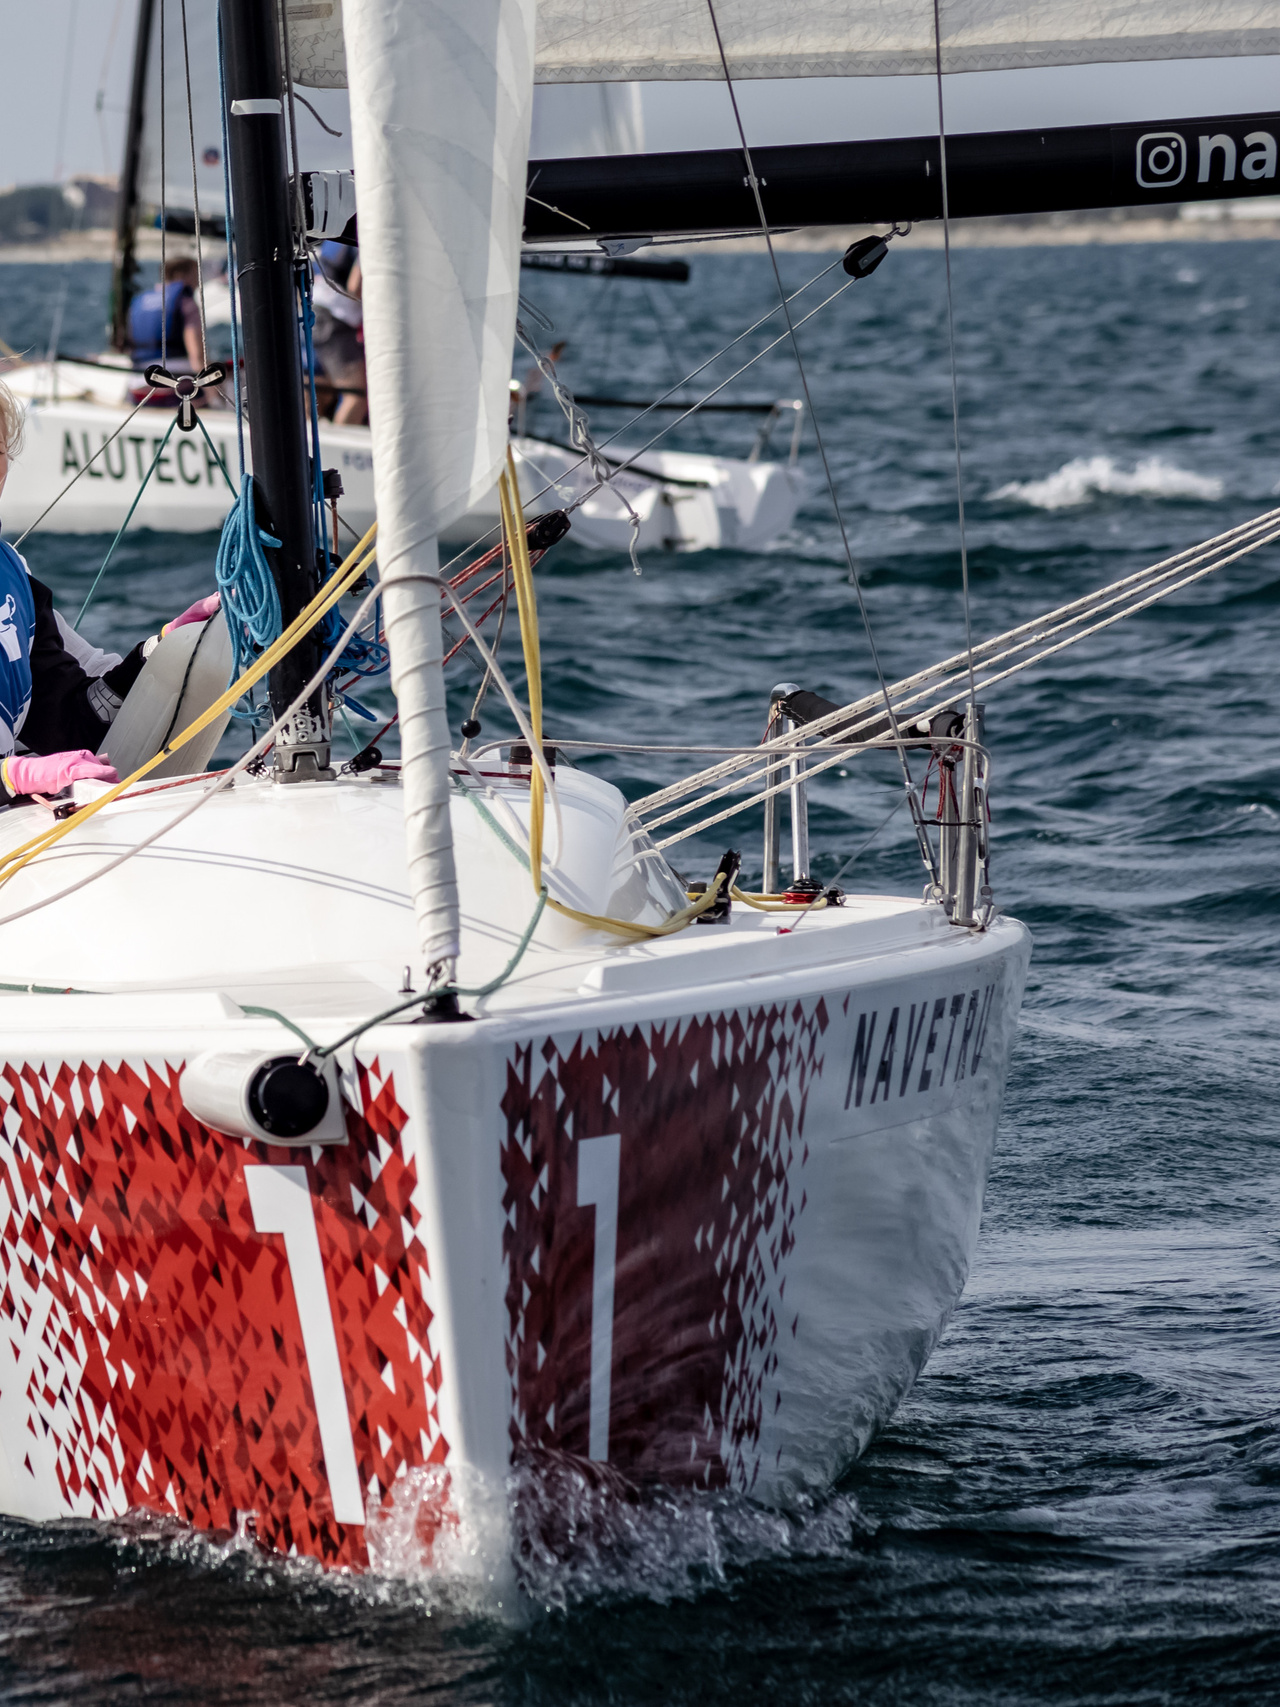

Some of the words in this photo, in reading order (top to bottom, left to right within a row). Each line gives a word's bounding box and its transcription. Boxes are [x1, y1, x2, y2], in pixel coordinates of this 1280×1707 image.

[62, 430, 231, 487] ALUTECH
[844, 984, 995, 1110] NAVETRU
[244, 1164, 365, 1525] 1
[577, 1133, 621, 1461] 1
